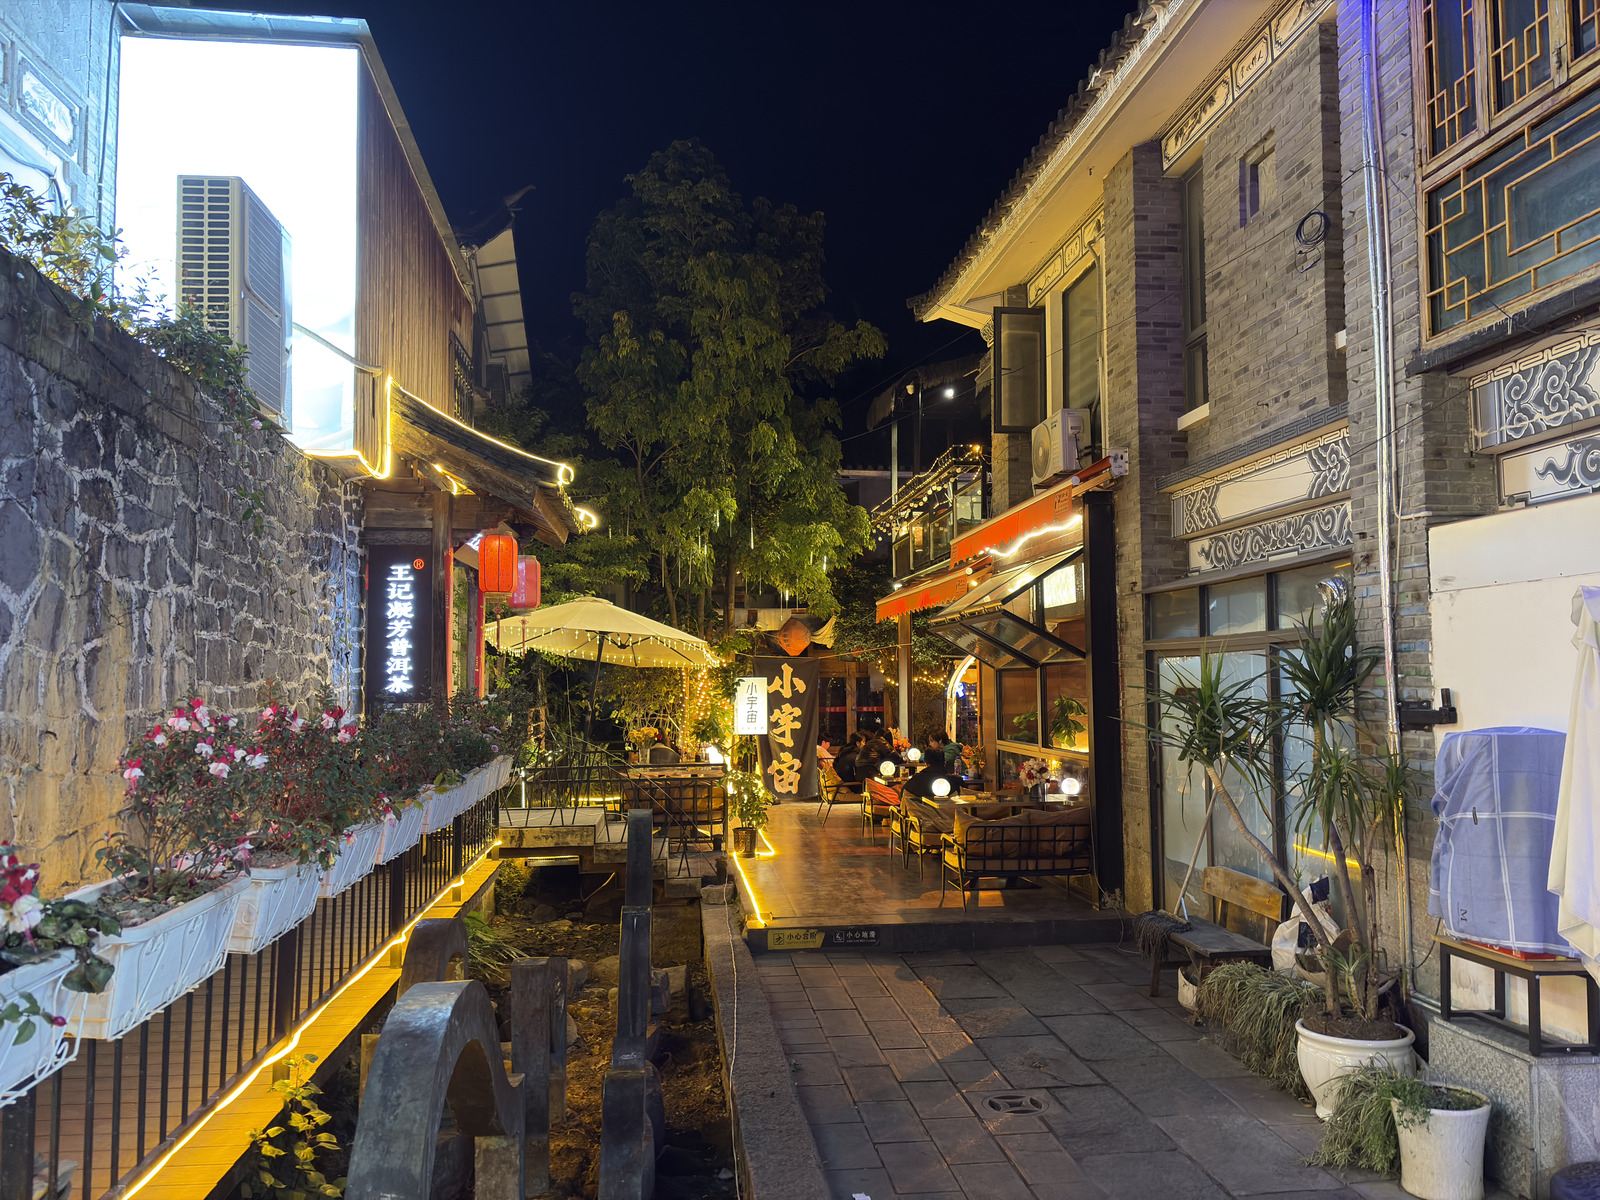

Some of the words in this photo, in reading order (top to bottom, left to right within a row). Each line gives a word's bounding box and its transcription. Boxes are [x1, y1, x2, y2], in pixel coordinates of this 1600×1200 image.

[385, 564, 414, 694] 王记凝芳普洱茶
[746, 682, 758, 723] 小宇宙
[767, 662, 807, 795] 小宇宙
[787, 932, 817, 941] 小心台阶
[846, 930, 876, 939] 小心地滑
